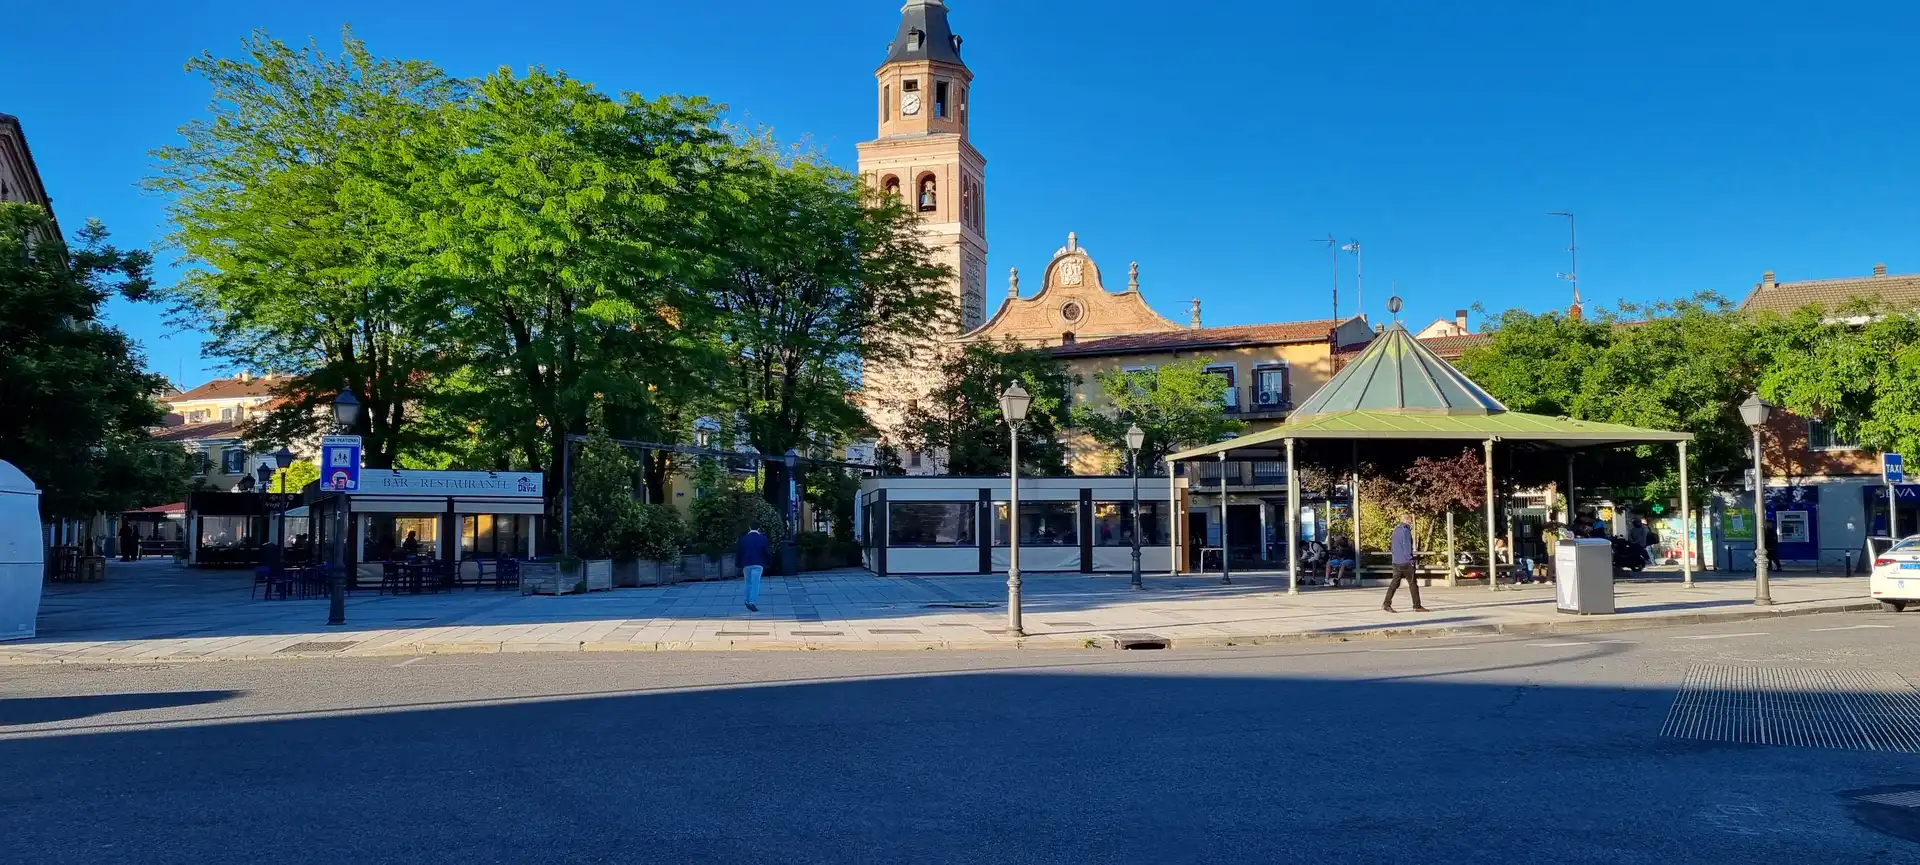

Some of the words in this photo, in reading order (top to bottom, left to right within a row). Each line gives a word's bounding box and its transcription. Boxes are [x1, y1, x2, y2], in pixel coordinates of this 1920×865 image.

[1886, 464, 1902, 473] TAXI
[383, 478, 409, 487] BAR
[420, 478, 510, 489] RESTAURANTE
[518, 484, 536, 492] David
[1192, 496, 1198, 504] 6
